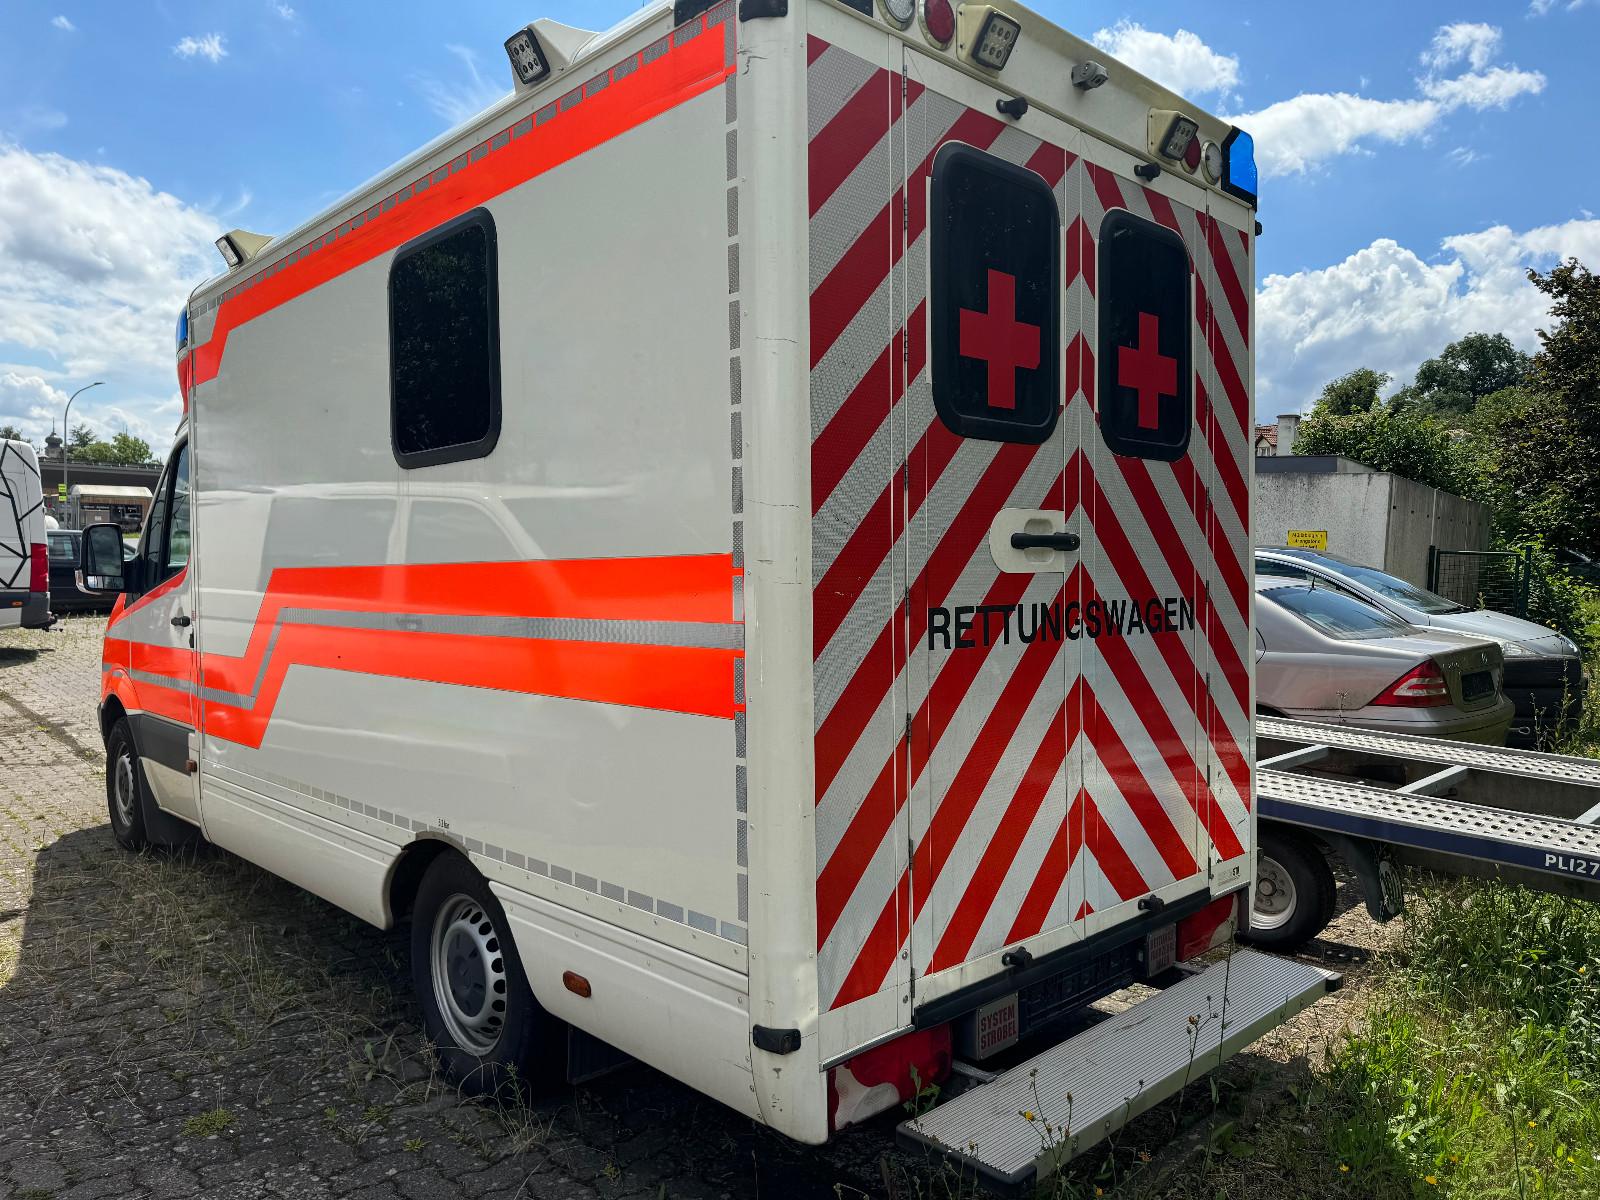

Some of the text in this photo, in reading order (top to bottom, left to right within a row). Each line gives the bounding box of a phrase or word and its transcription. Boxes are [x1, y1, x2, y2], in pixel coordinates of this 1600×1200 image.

[928, 597, 1195, 650] RETTUNGSWAGEN
[980, 1003, 1015, 1032] SYSTEM
[980, 1021, 1017, 1050] STROBEL
